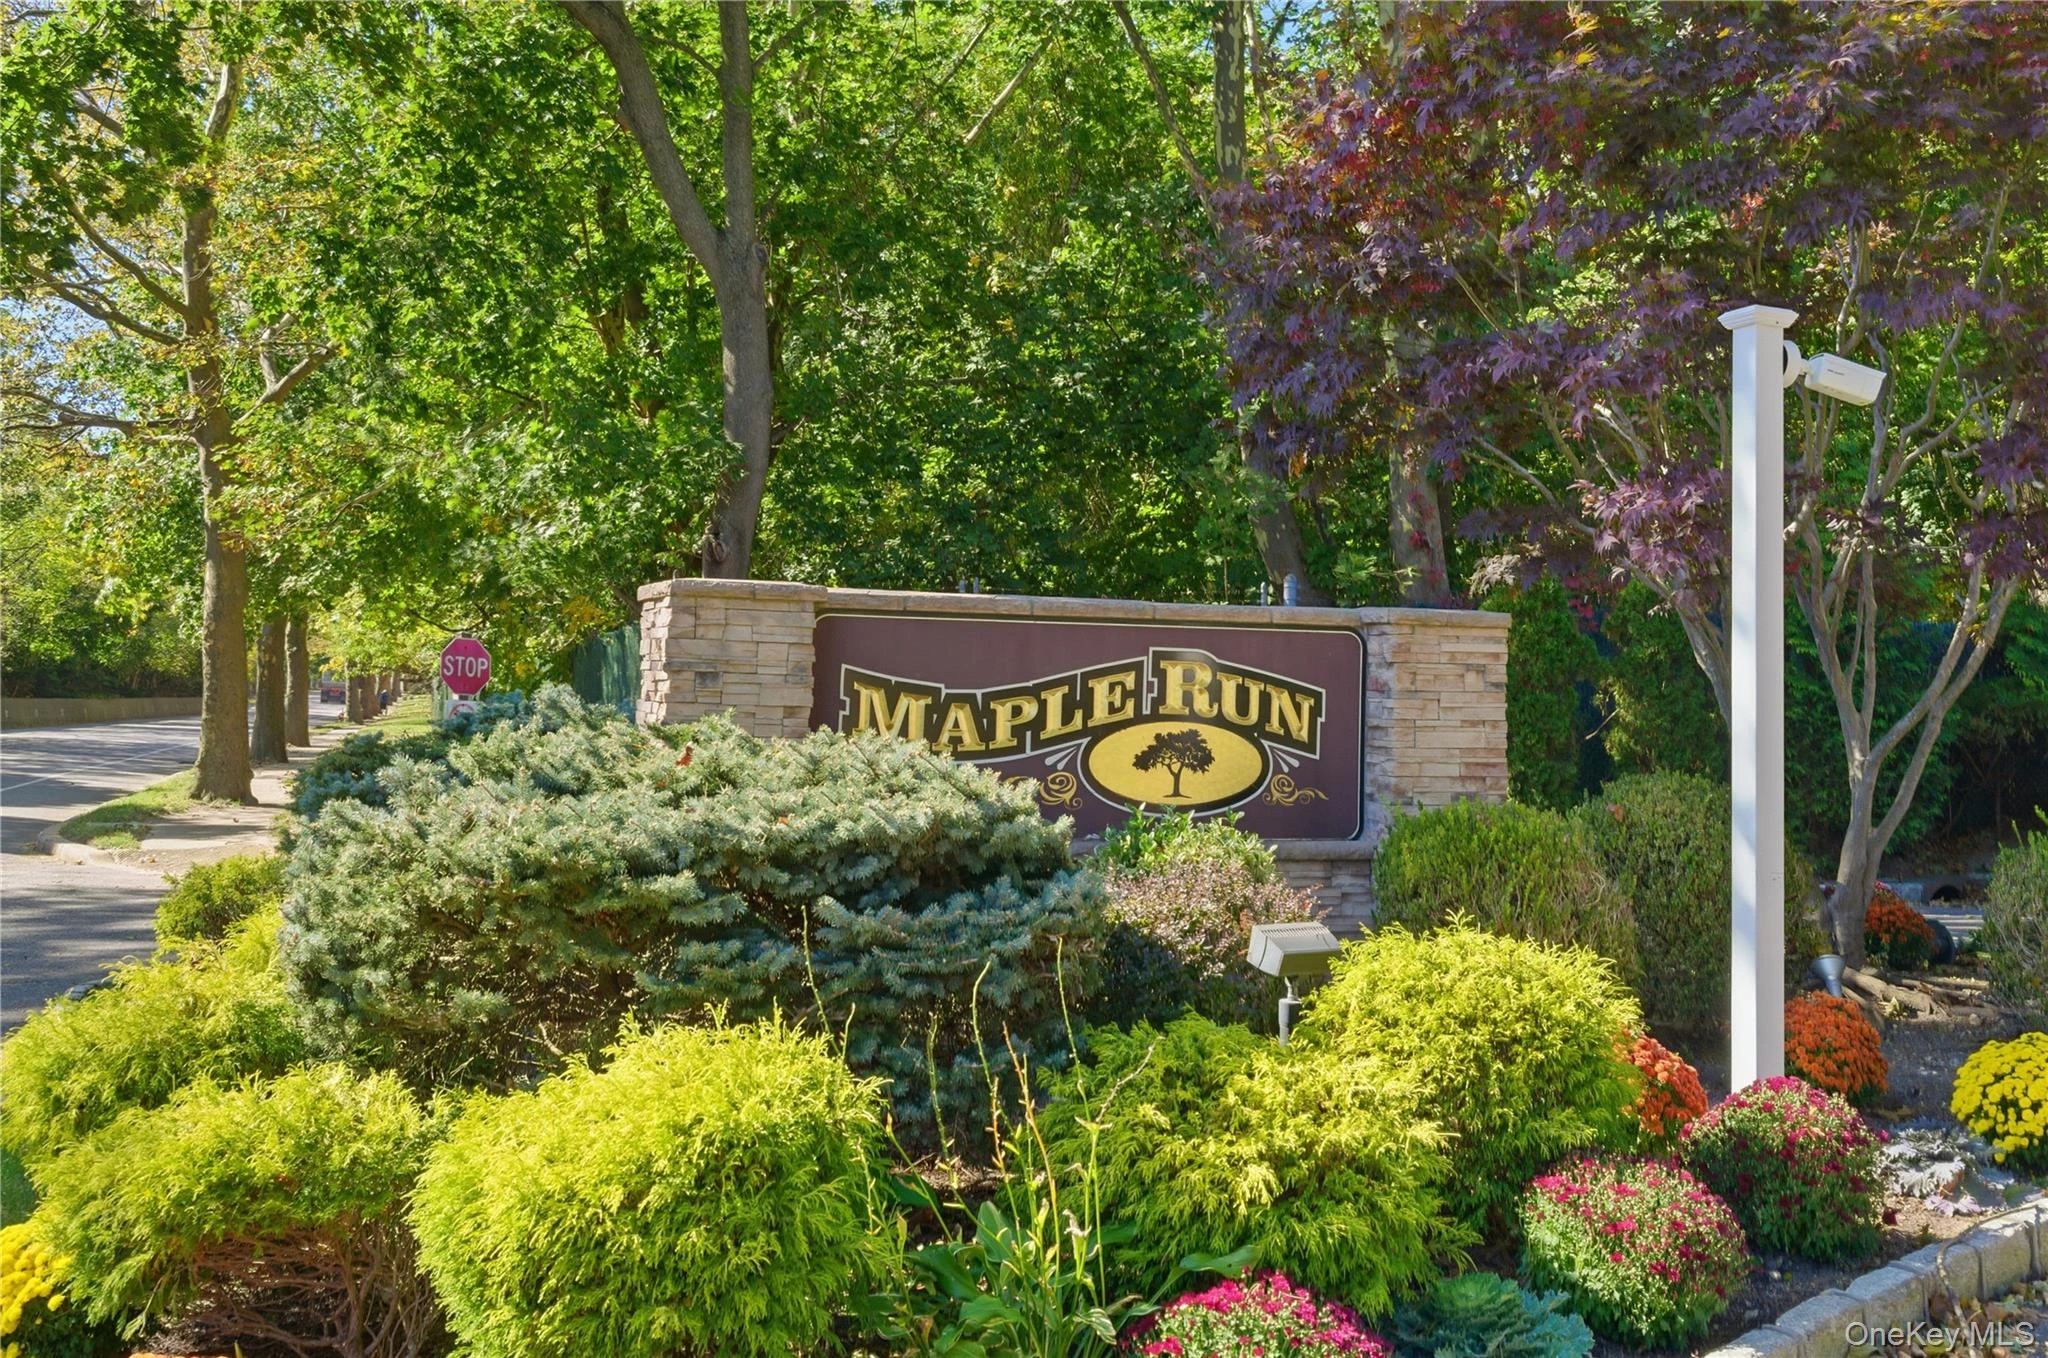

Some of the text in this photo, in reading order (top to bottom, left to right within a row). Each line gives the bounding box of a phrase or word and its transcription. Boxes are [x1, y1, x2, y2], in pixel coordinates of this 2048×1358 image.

[443, 655, 488, 678] STOP
[852, 659, 1316, 752] MAPLE RUN
